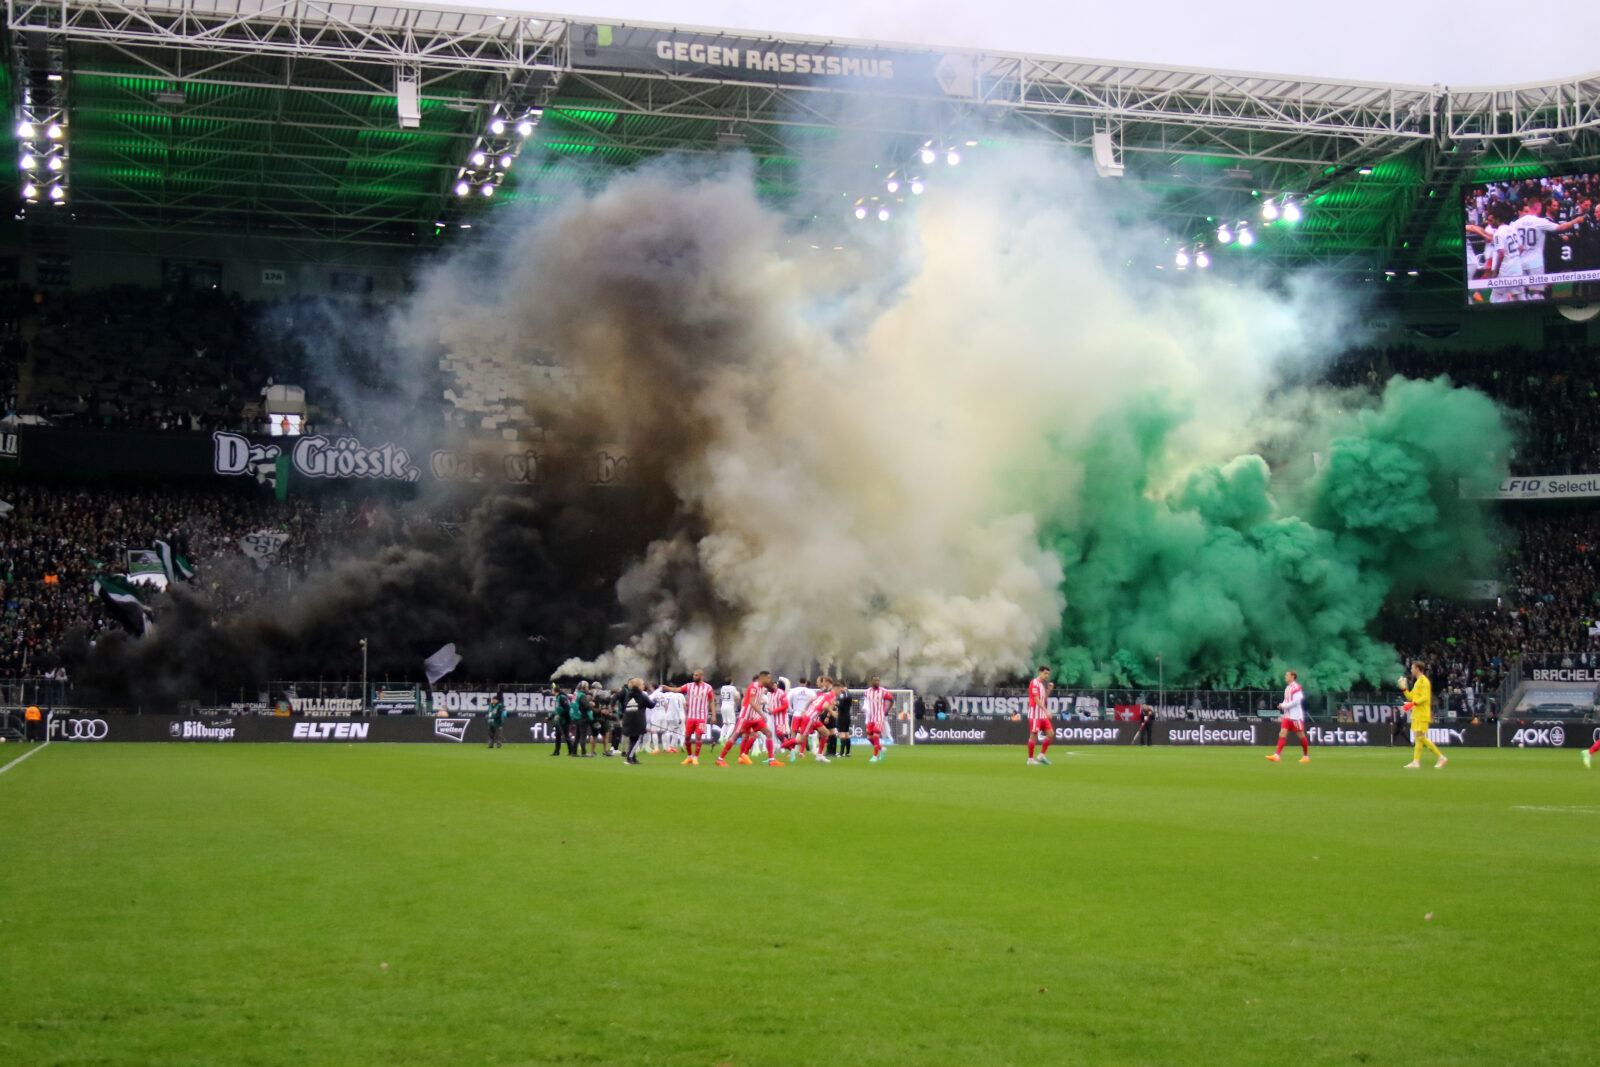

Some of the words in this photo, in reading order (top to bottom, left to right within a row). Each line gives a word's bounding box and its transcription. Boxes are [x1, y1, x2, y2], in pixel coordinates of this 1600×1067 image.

[656, 40, 739, 68] GEGEN
[746, 50, 894, 79] RASSISMUS
[1487, 278, 1527, 288] Achtung:
[1529, 275, 1549, 284] Bitte
[947, 696, 1072, 714] VITUSSTDT
[182, 720, 236, 741] Bitburger
[293, 722, 370, 739] ELTEN
[930, 728, 986, 739] Santander
[1055, 727, 1119, 741] sonepar
[1169, 725, 1255, 744] sure[secure]
[1307, 726, 1368, 743] flatex
[1511, 728, 1550, 743] AOK
